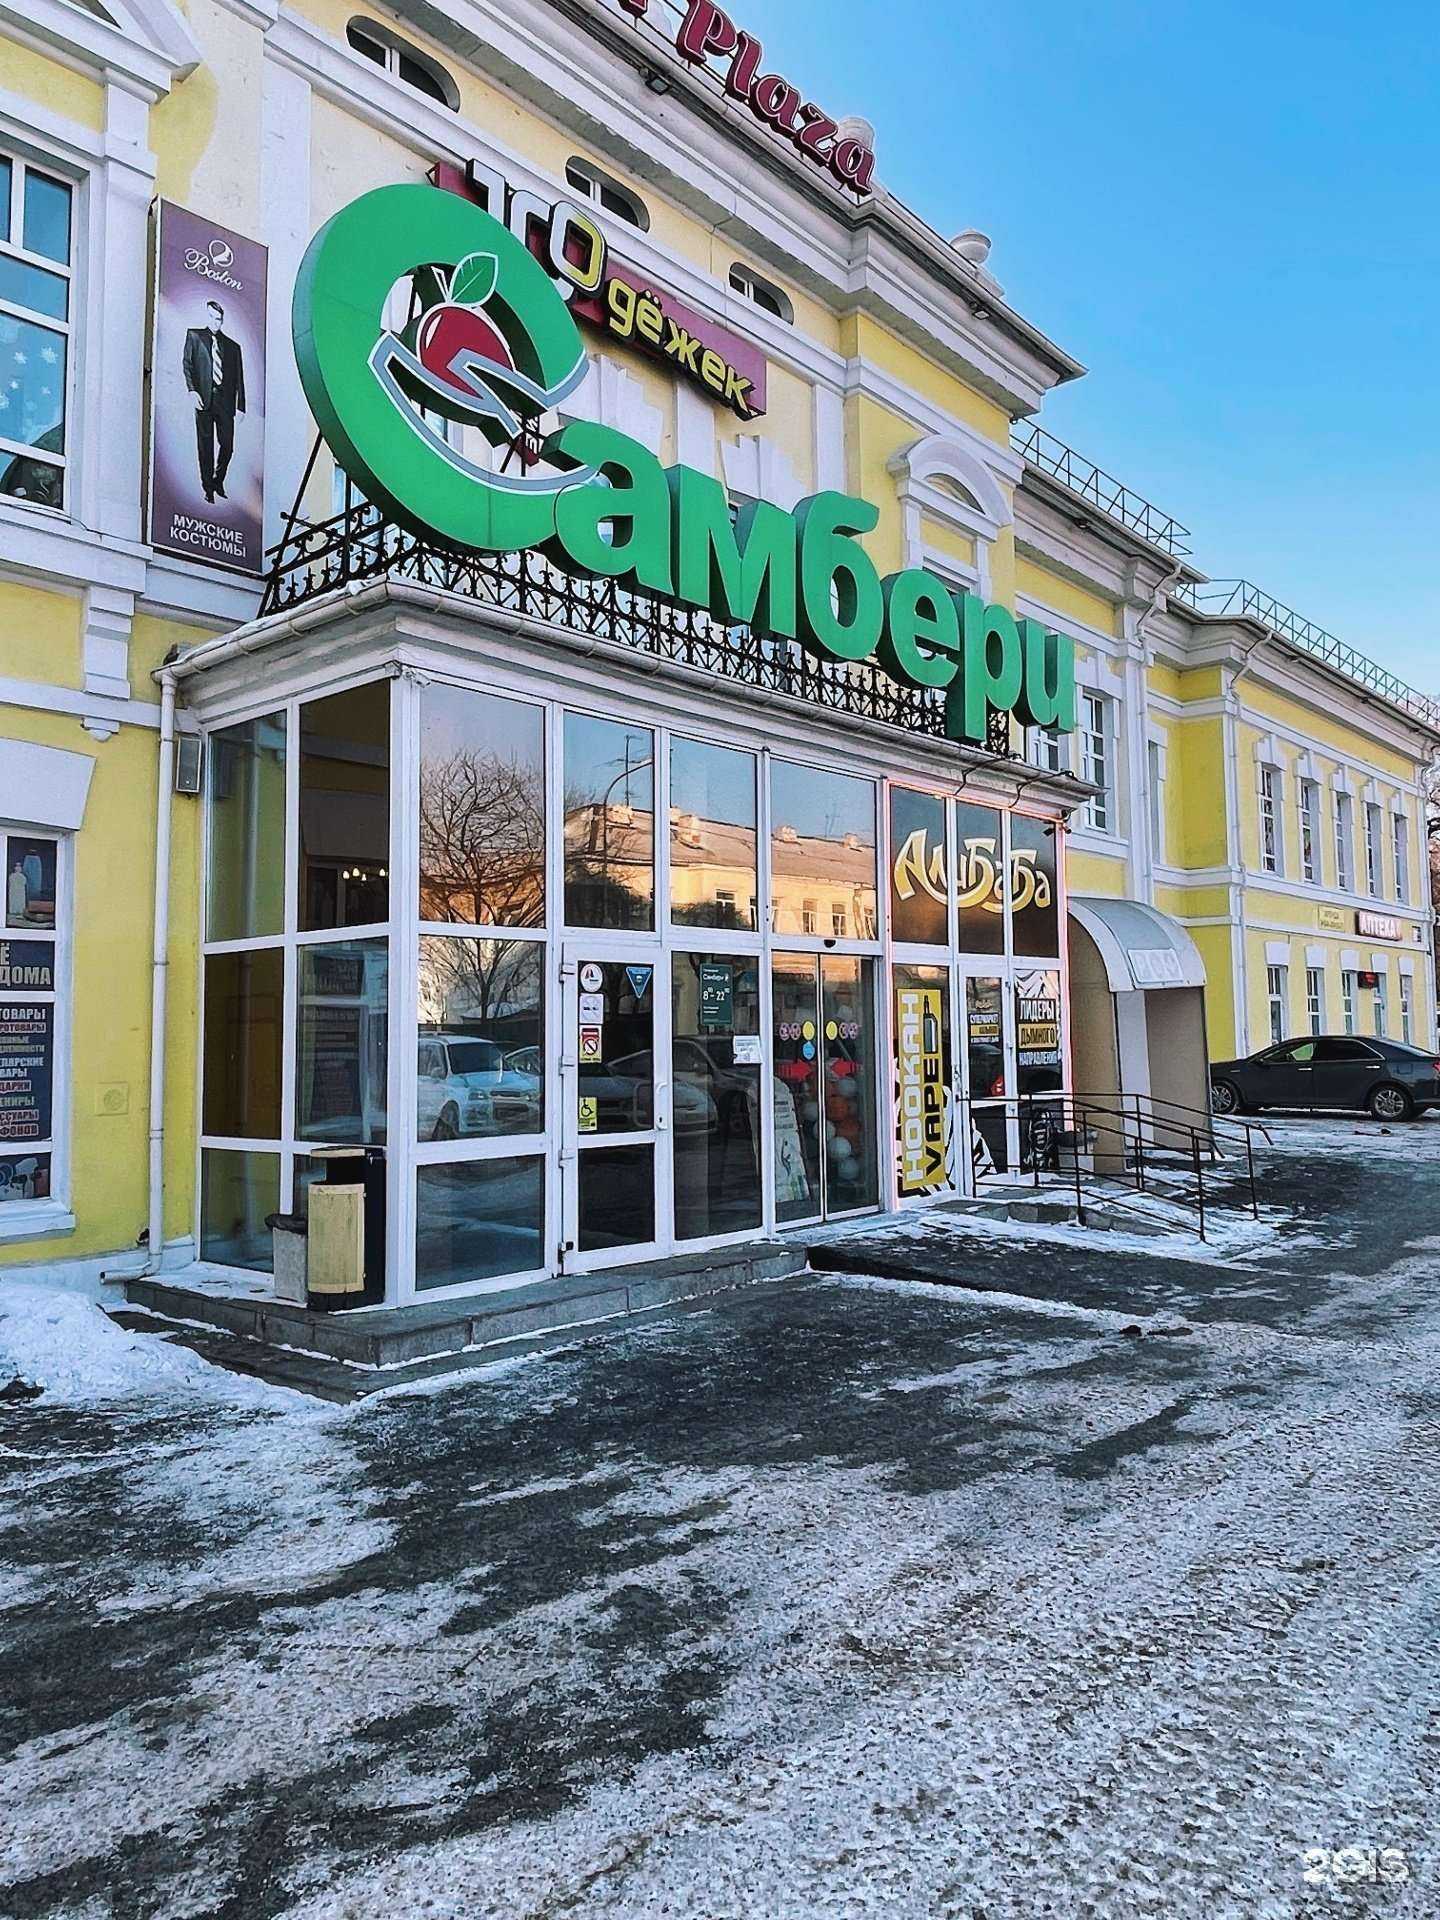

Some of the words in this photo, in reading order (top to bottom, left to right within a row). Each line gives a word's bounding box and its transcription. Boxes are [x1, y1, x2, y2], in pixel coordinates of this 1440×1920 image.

[678, 0, 875, 196] Plaza
[183, 248, 243, 291] Boston
[292, 184, 1075, 743] Самбери
[170, 526, 247, 557] КОСТЮМЫ
[173, 514, 244, 544] МУЖСКИЕ
[0, 966, 51, 987] ДОМА
[1019, 999, 1055, 1022] ЛИДЕРЫ
[1020, 1026, 1056, 1046] ДЫМНОГО
[902, 992, 924, 1182] HOOKAH
[923, 1058, 942, 1177] VAPE
